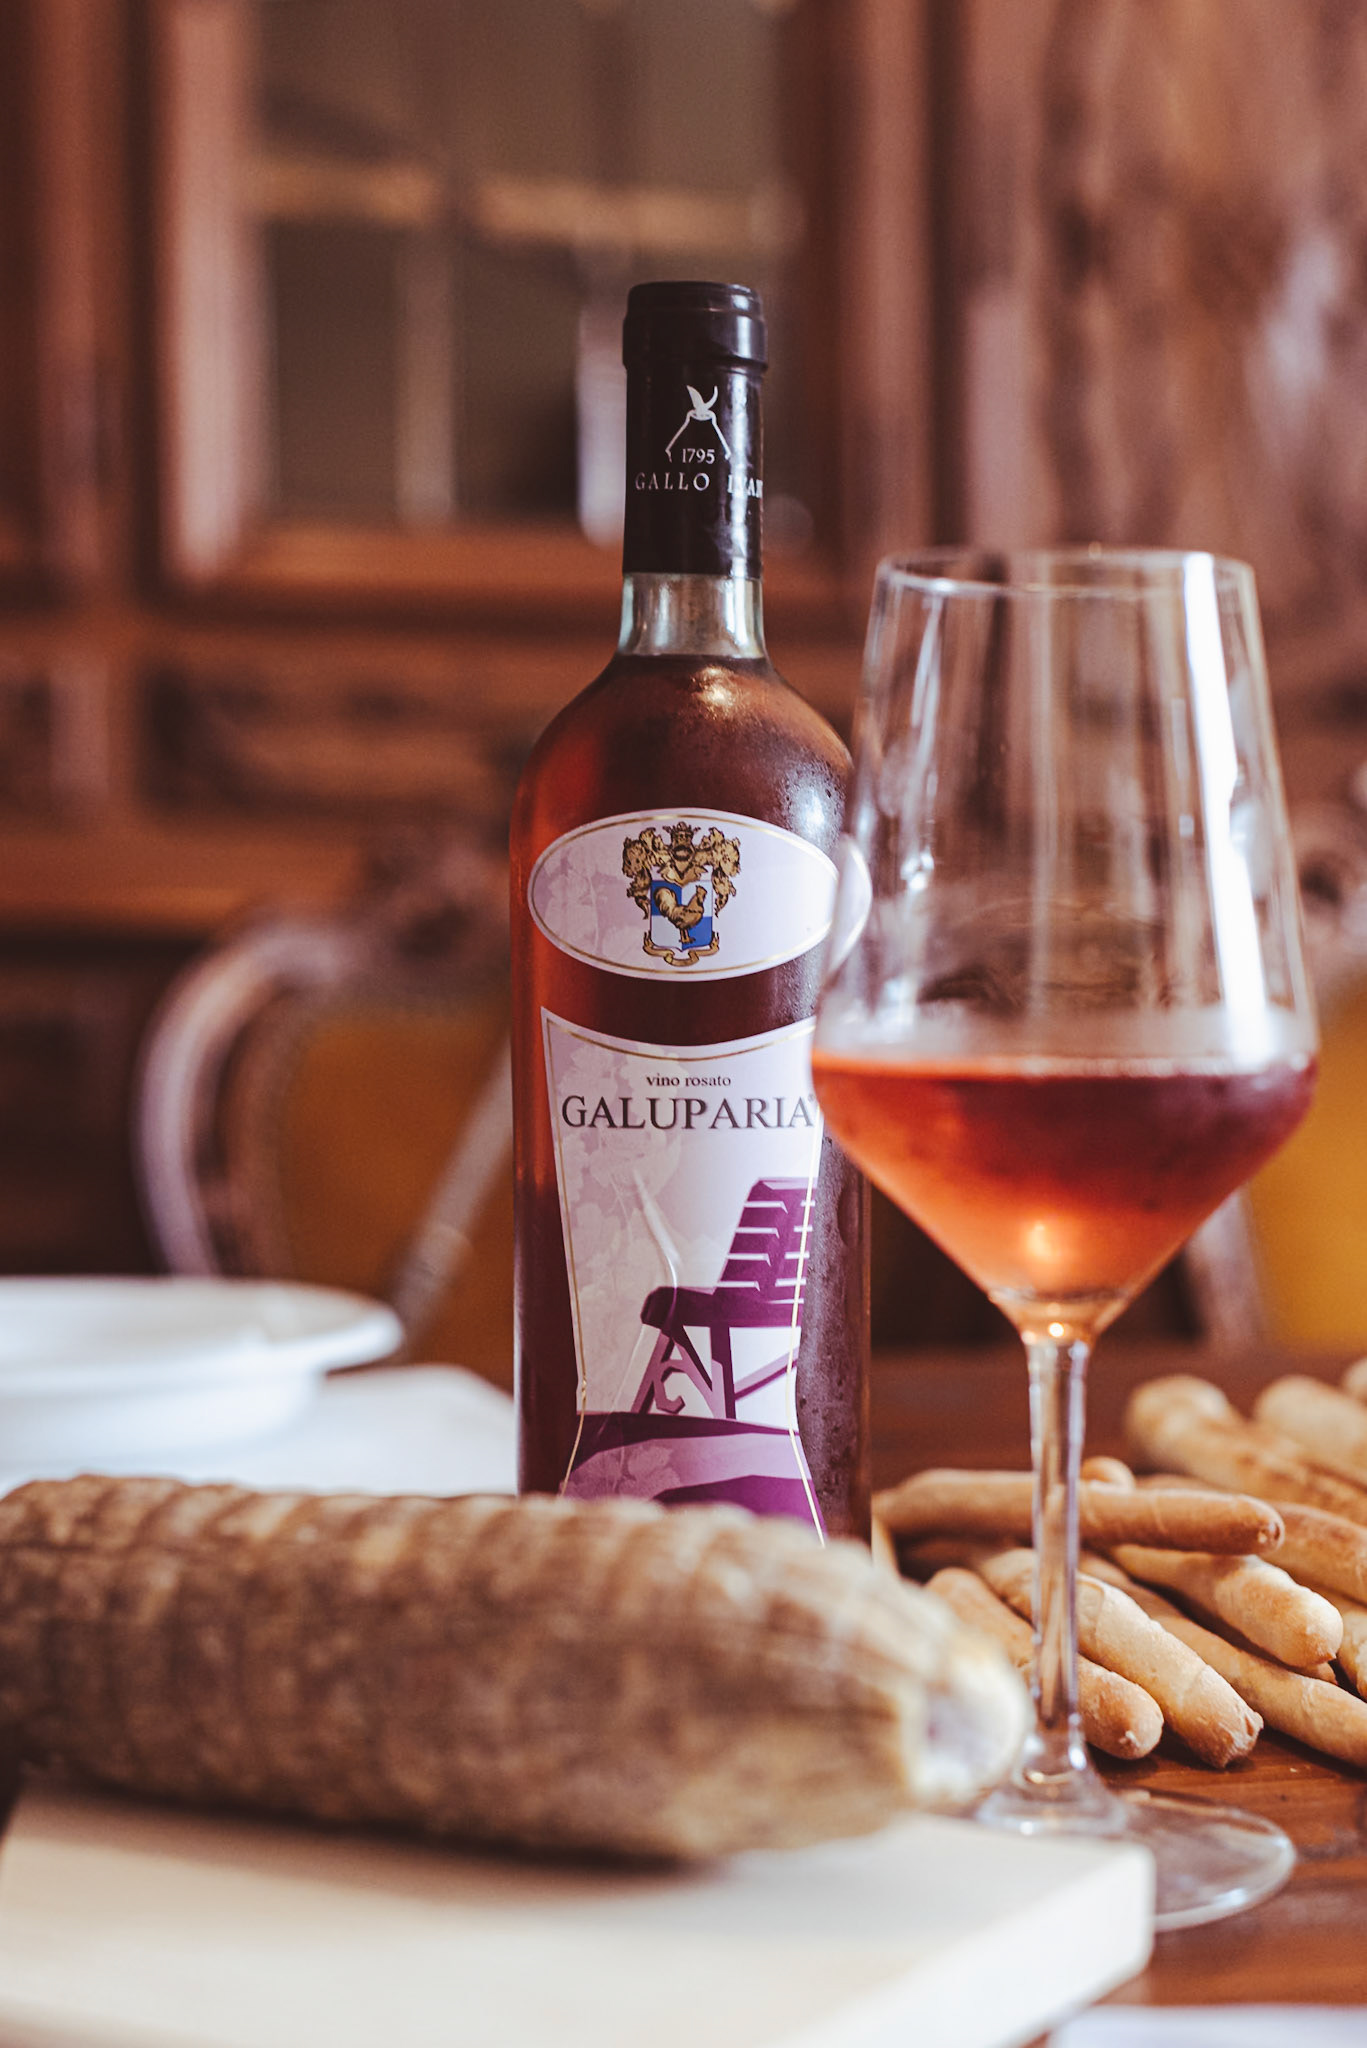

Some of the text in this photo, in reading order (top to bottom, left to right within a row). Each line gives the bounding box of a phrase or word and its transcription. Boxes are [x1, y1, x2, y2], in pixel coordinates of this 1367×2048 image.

[682, 448, 716, 464] 1795
[635, 472, 710, 491] GALLO
[646, 1073, 731, 1087] vino rosato
